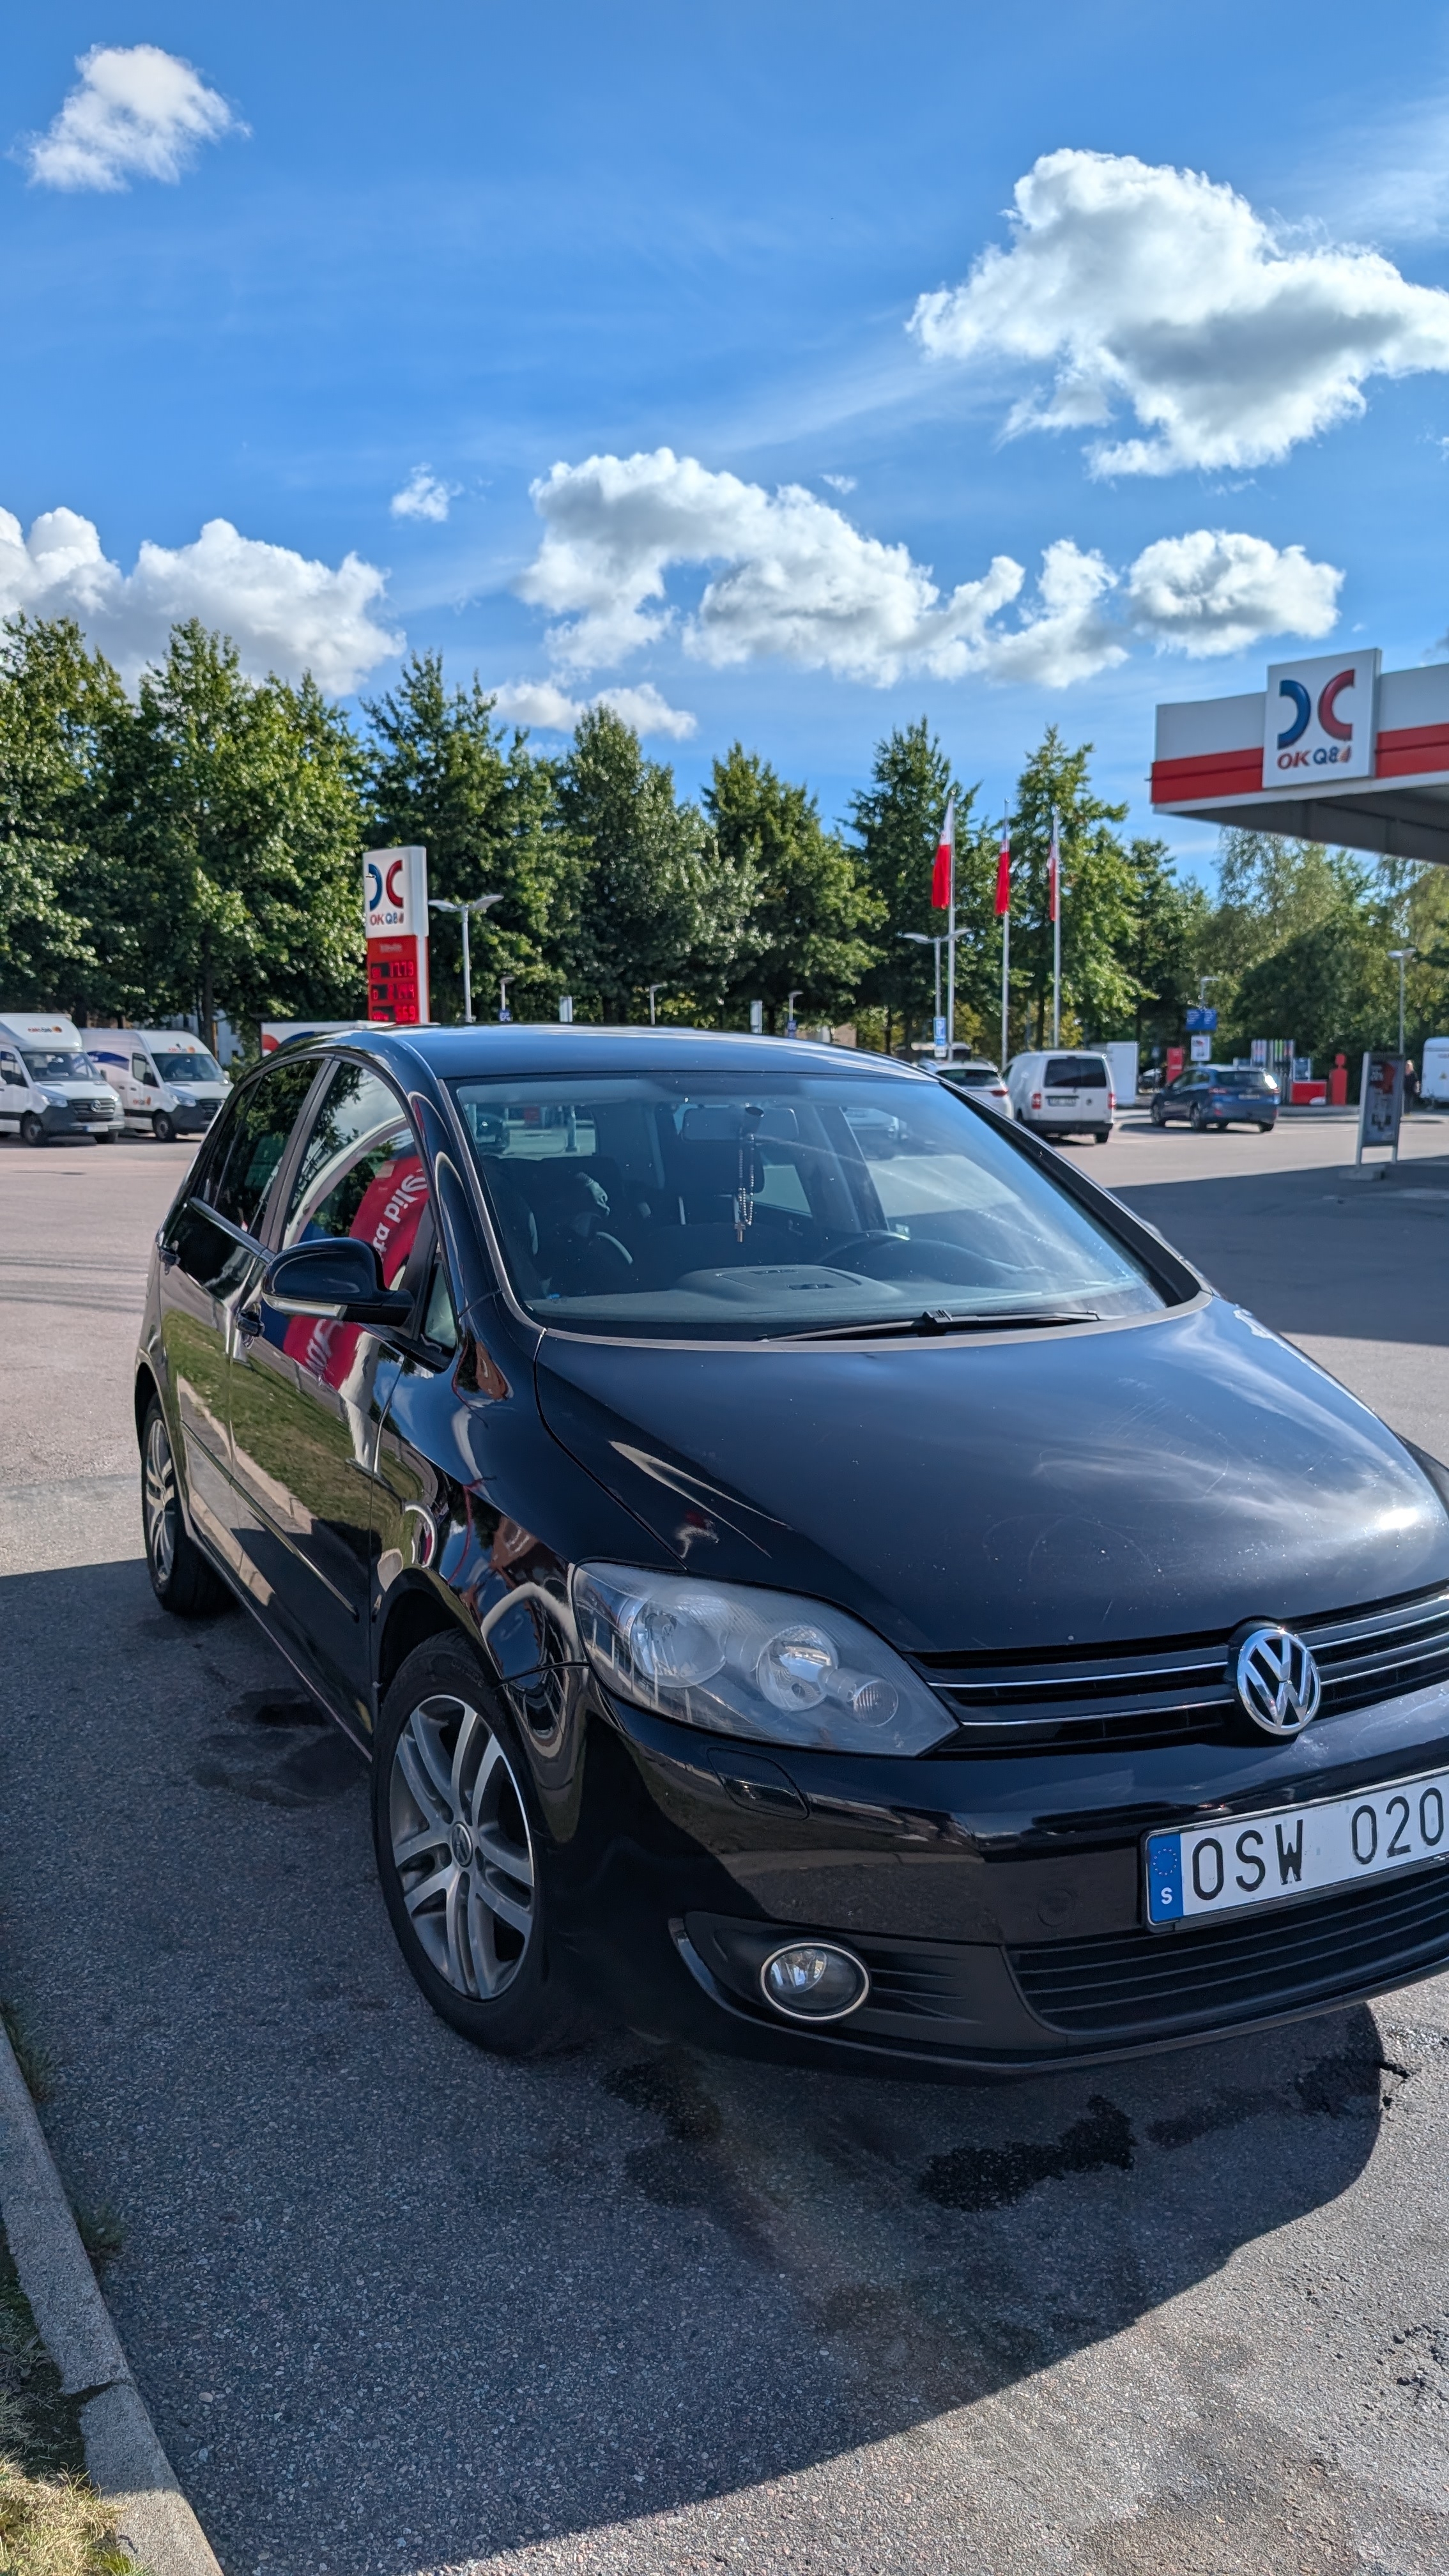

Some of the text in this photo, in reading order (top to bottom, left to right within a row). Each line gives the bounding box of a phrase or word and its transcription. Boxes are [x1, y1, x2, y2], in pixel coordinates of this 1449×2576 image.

[1192, 1786, 1444, 1901] OSW 020
[1160, 1887, 1173, 1905] S
